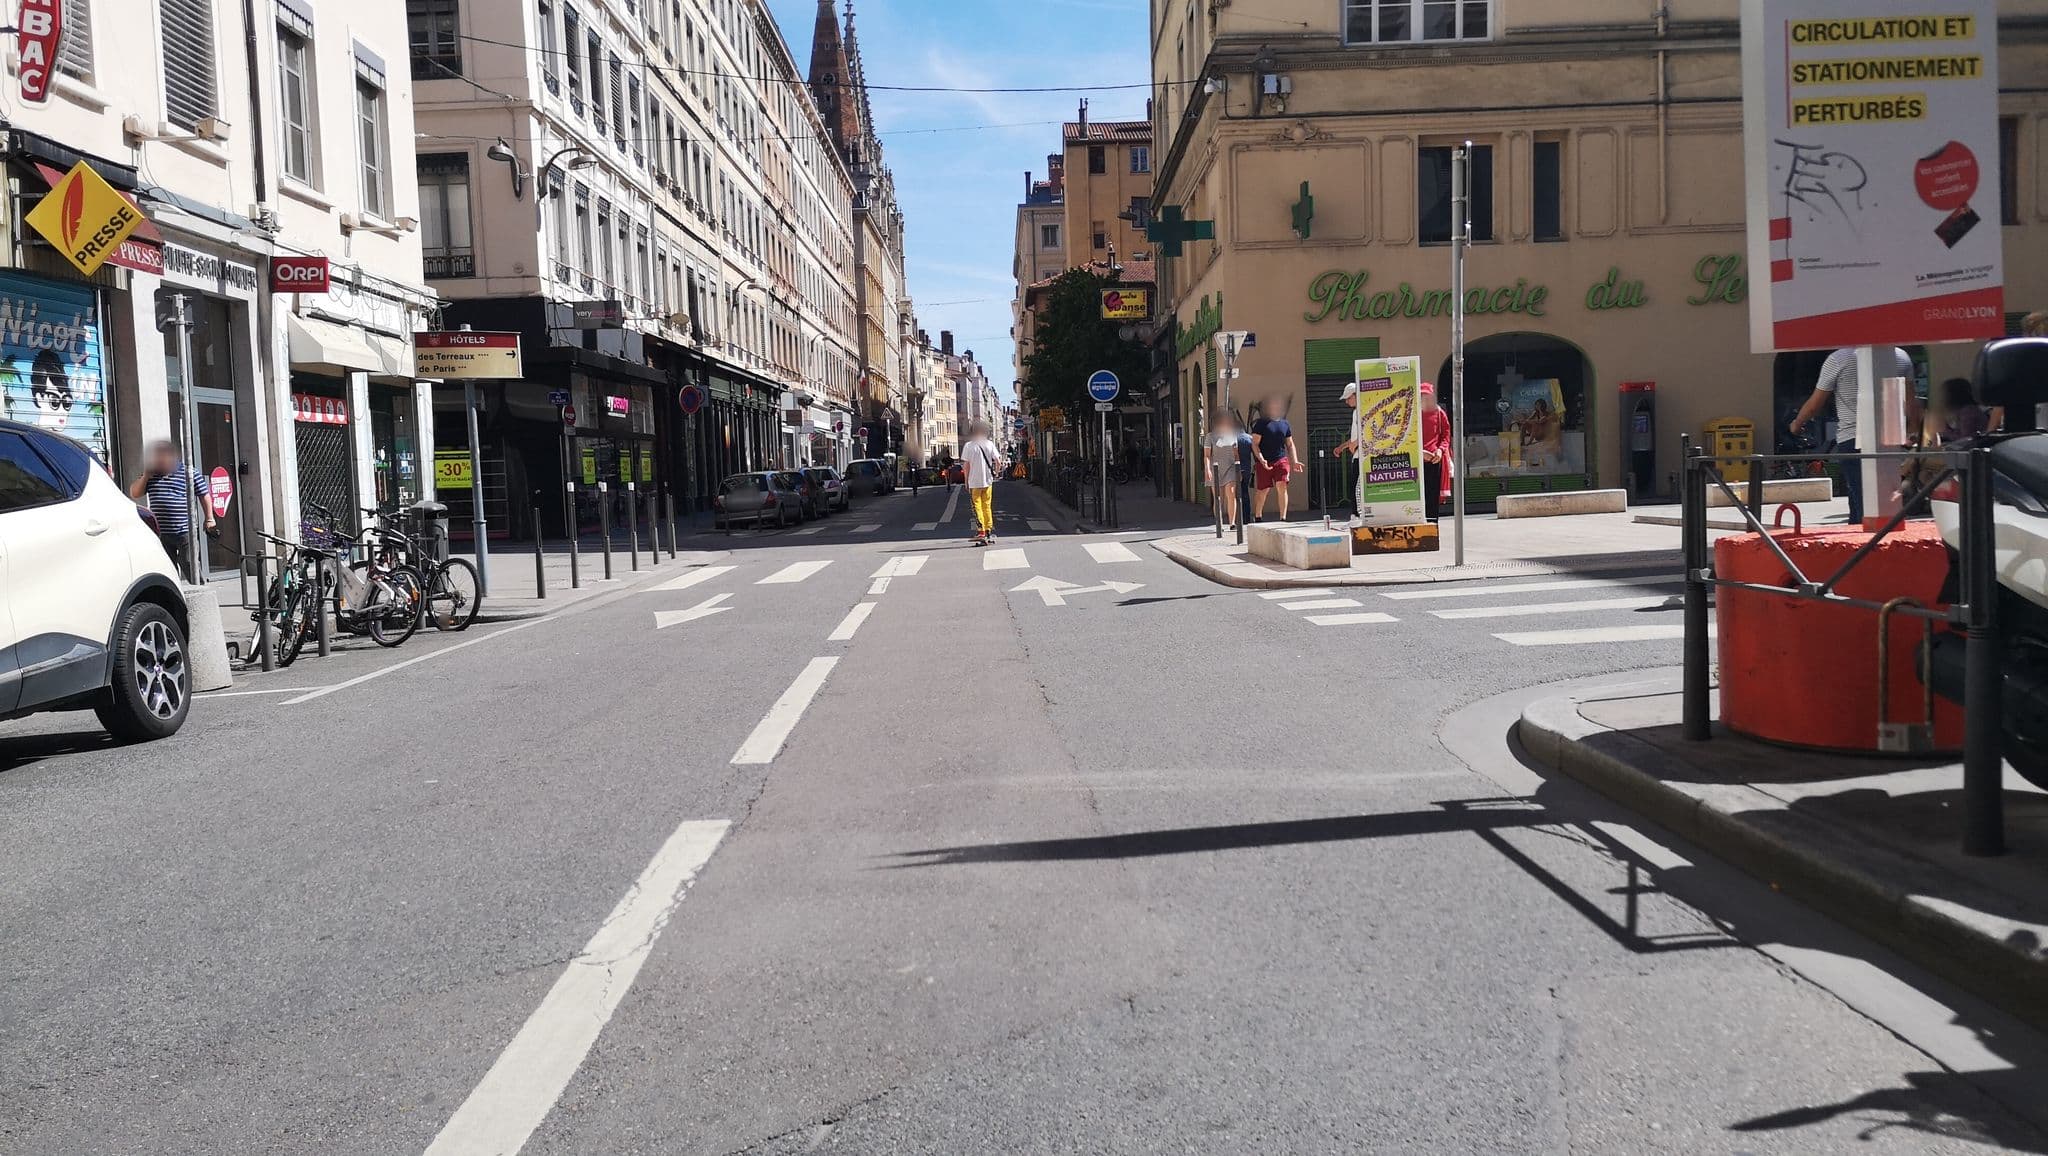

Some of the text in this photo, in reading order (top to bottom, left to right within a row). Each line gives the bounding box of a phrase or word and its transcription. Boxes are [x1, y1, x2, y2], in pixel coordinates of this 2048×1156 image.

[1792, 17, 1971, 42] CIRCULATION ET
[21, 0, 52, 93] BAC
[1793, 57, 1980, 83] STATIONNEMENT
[1794, 96, 1922, 123] PERTURBÉS
[75, 207, 134, 266] PRESSE
[277, 263, 324, 281] ORPI
[1303, 254, 1746, 322] Pharmacie du Se
[450, 334, 486, 344] HÔTELS
[1370, 471, 1409, 482] NATURE
[1372, 461, 1409, 470] PARLONS
